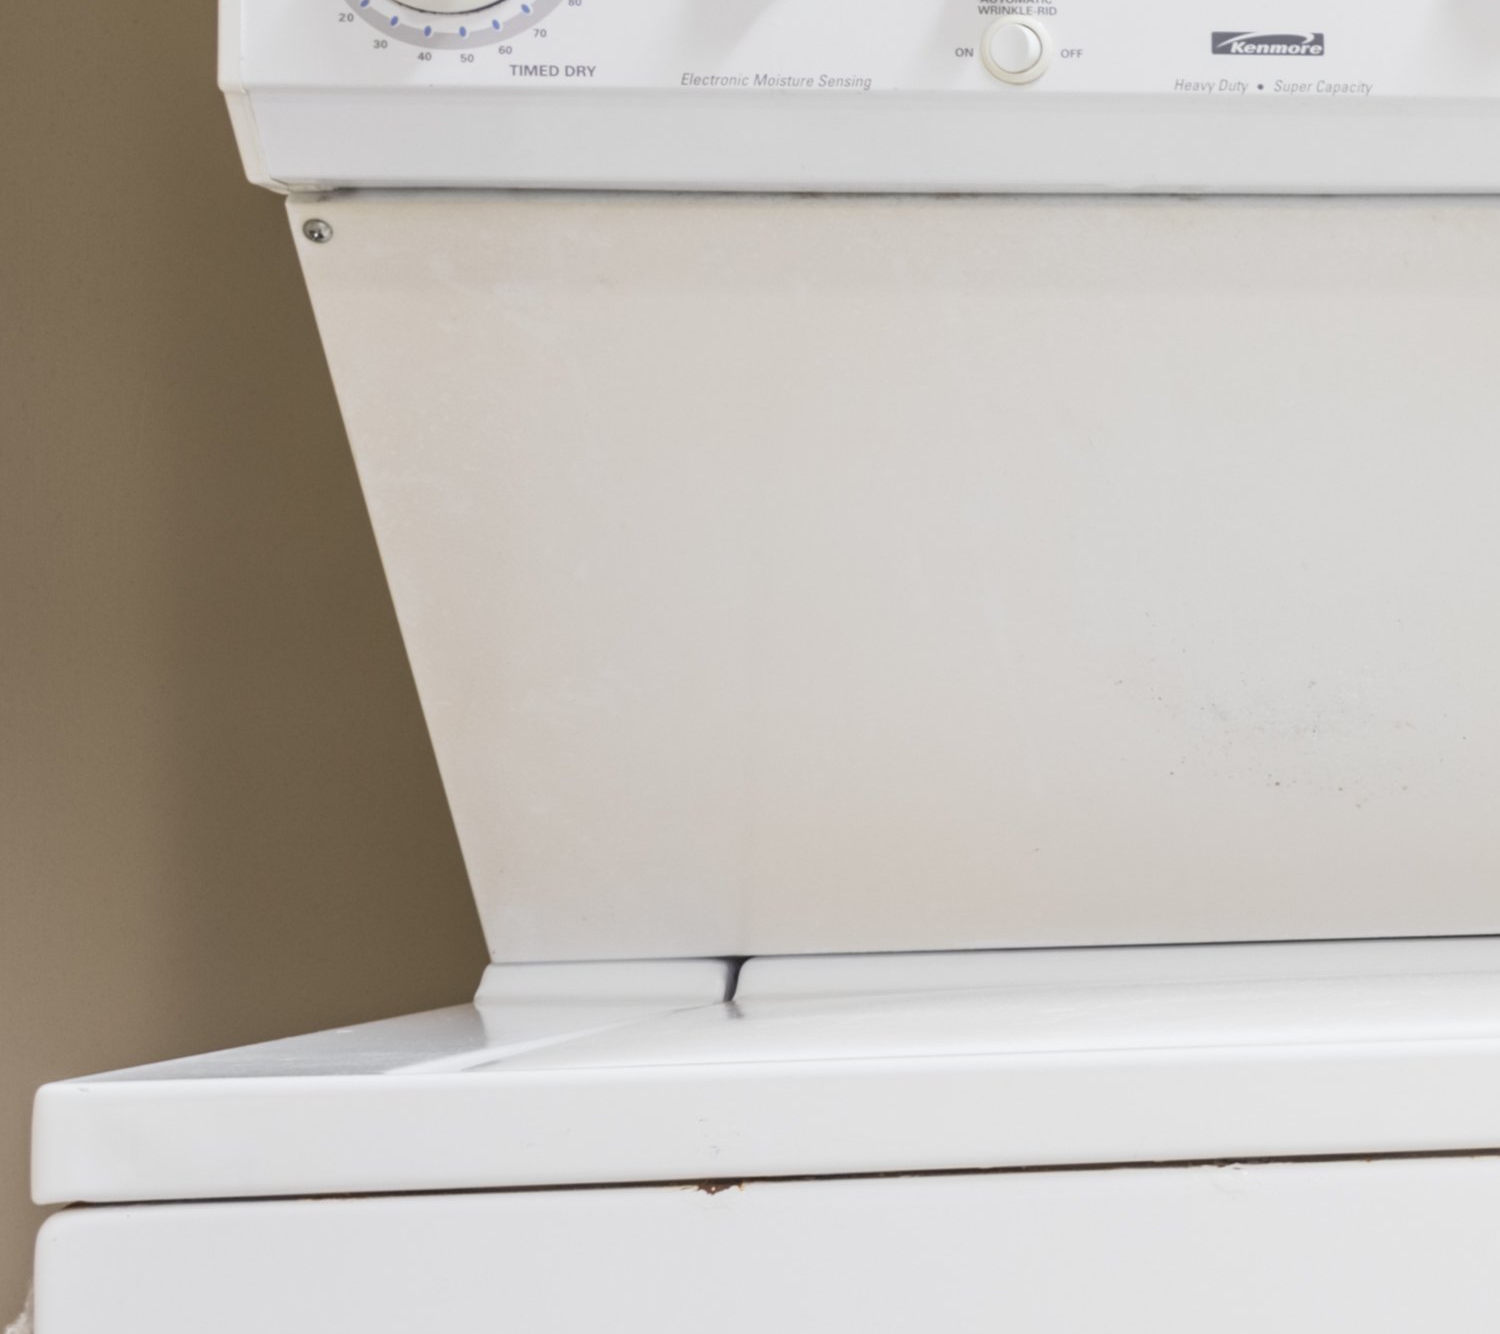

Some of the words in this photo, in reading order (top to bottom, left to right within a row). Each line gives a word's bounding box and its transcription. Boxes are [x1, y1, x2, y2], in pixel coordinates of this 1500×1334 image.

[978, 5, 1057, 16] WRINKLE-RID
[339, 12, 354, 23] 20
[533, 28, 547, 38] 70
[373, 39, 388, 49] 30
[1230, 39, 1323, 55] Kenmore
[498, 45, 512, 55] 60
[955, 48, 974, 58] ON
[1061, 48, 1083, 59] OFF
[418, 51, 432, 61] 40
[460, 53, 474, 63] 50
[510, 64, 559, 78] TIMED
[564, 65, 596, 79] DRY
[681, 73, 750, 88] Electronic
[754, 74, 814, 88] Moisture
[818, 74, 872, 91] Sensing
[1174, 79, 1216, 95] Heavy
[1219, 80, 1249, 95] Duty
[1274, 80, 1313, 95] Super
[1317, 81, 1372, 97] Capacity
